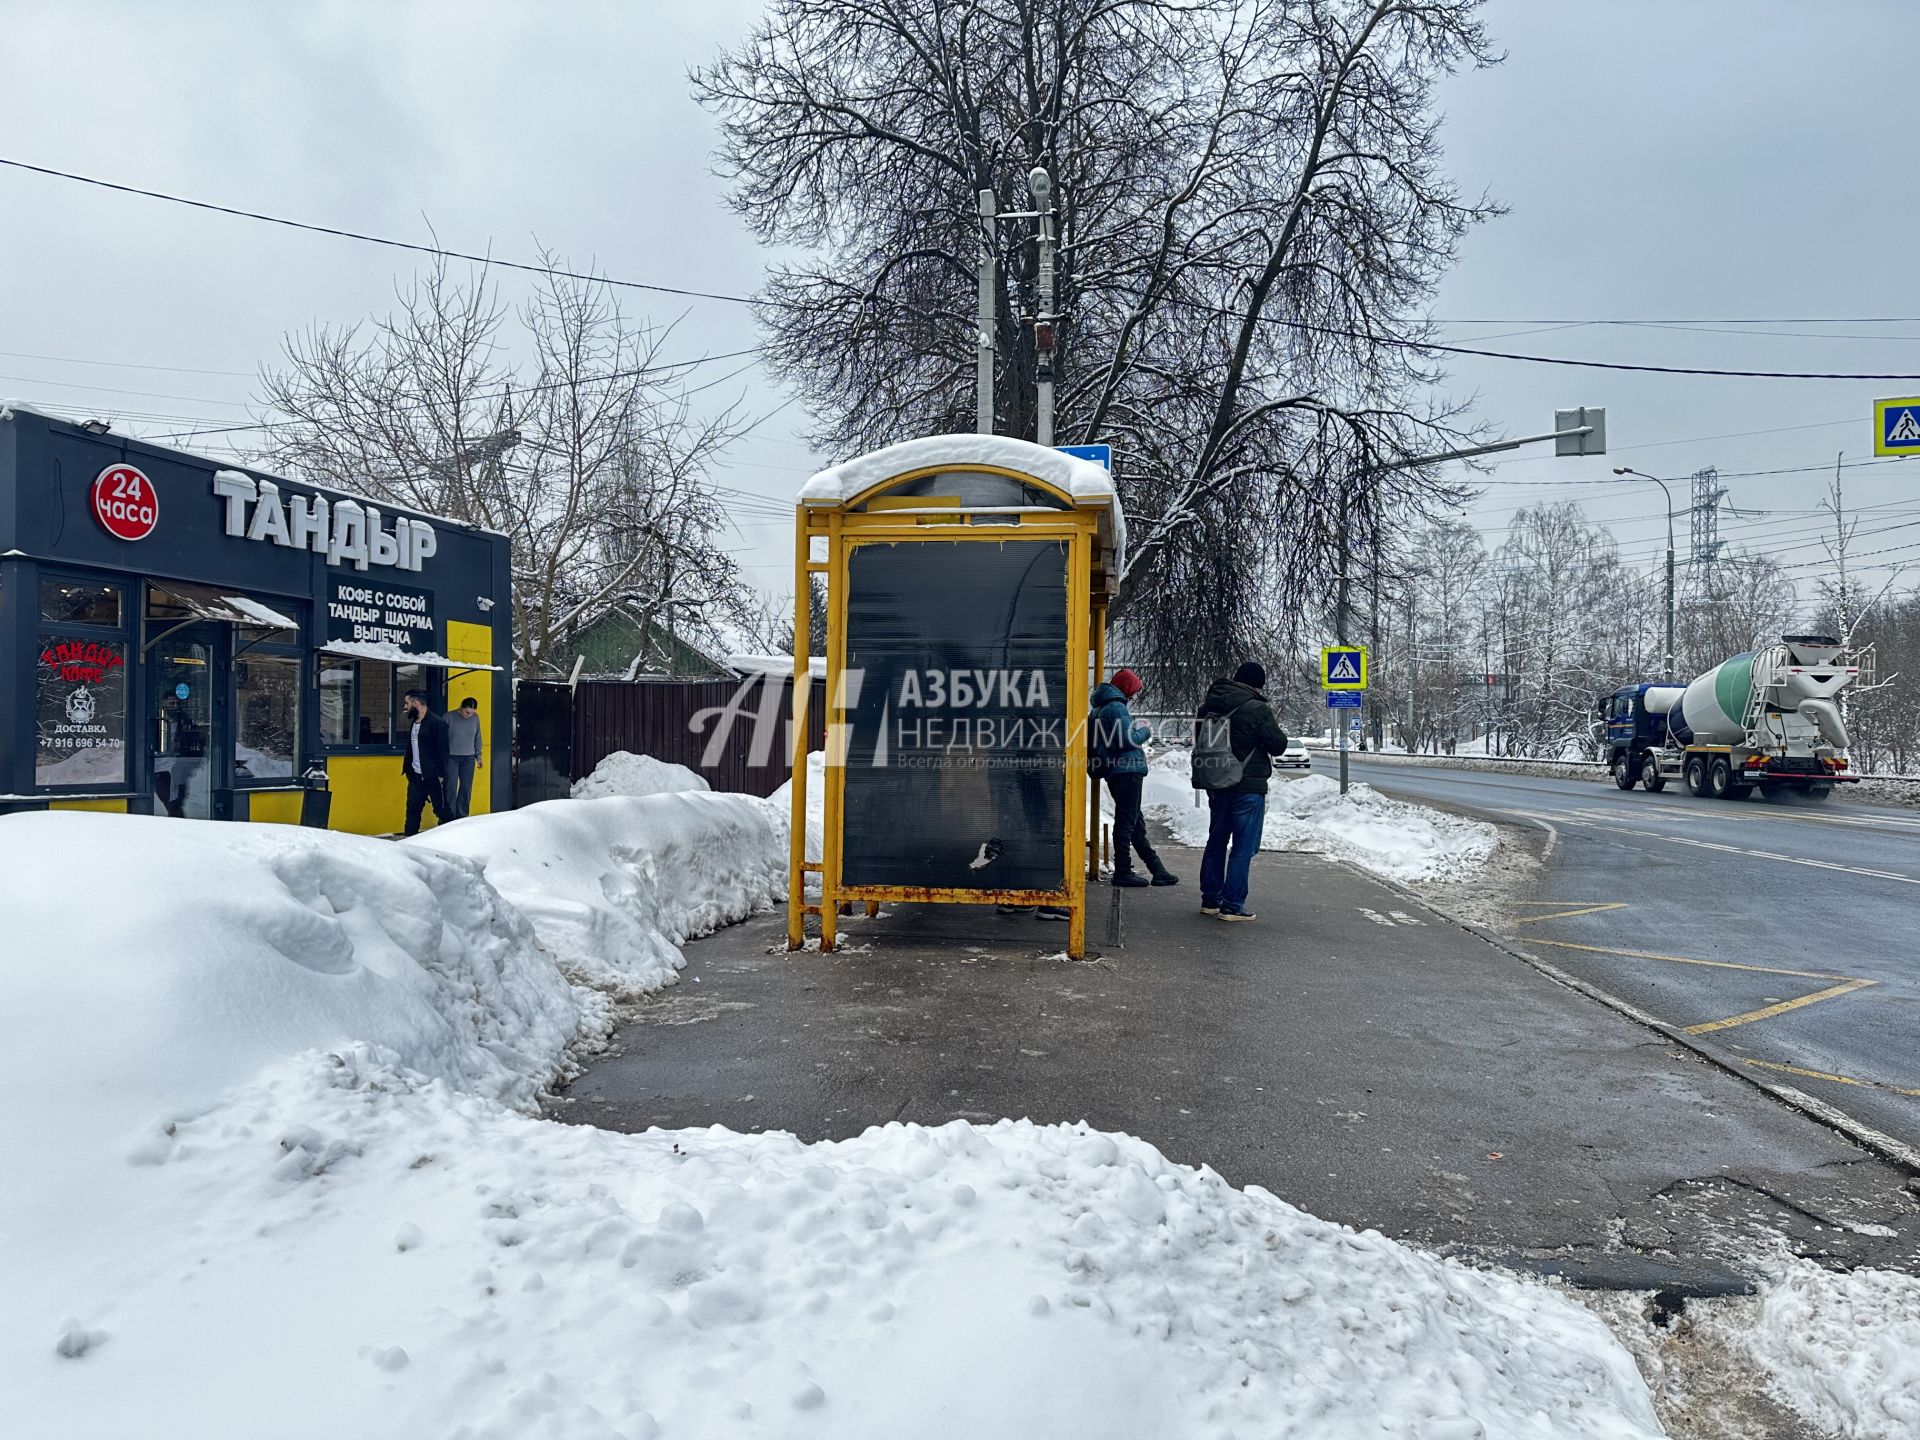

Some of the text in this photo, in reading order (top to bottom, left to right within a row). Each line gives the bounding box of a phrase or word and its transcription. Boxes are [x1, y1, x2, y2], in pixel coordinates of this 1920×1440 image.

[112, 472, 142, 501] 24
[100, 498, 153, 525] часа
[214, 473, 437, 571] ТАНДЫР
[338, 585, 426, 612] КОФЕ С СОБОЙ
[328, 602, 433, 630] ТАНДЫР ШАУРМА
[353, 625, 411, 645] ВЫПЕЧКА
[61, 665, 104, 684] КАФЕ
[54, 724, 107, 733] ДОСТАВКА
[40, 738, 52, 748] +7
[55, 738, 73, 748] 916
[75, 738, 93, 748] 696
